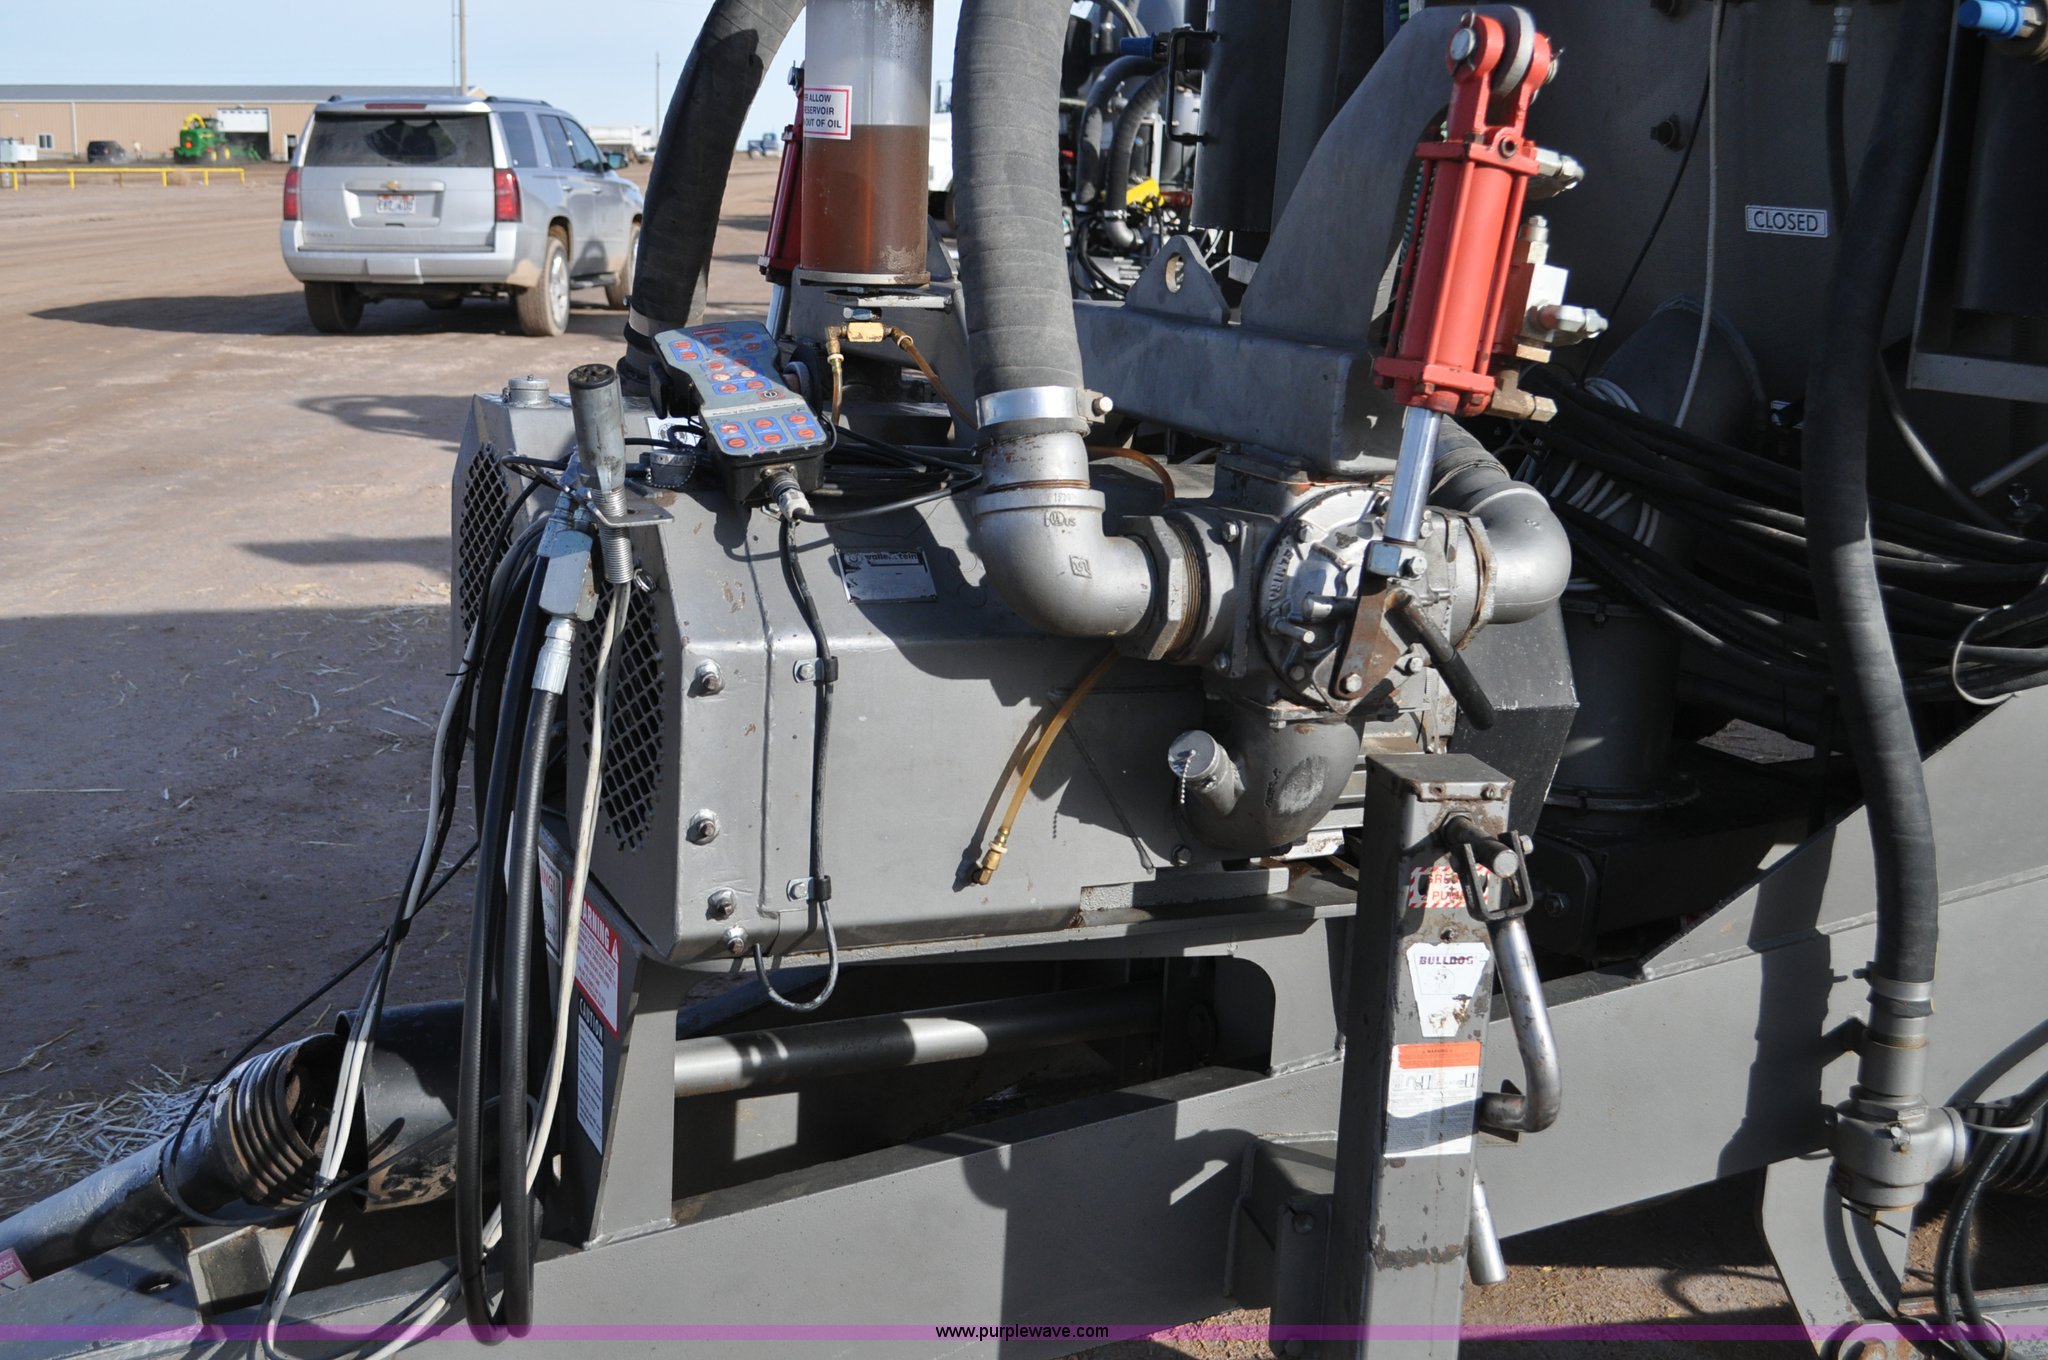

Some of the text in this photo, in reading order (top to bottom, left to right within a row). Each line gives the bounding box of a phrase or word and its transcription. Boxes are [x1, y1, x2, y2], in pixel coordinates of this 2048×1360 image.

[809, 94, 831, 103] ALLOW
[816, 118, 826, 128] OF
[827, 119, 842, 128] OIL
[1753, 210, 1818, 231] CLOSED
[582, 899, 610, 949] ARNING
[1419, 955, 1474, 965] BULLDOG
[579, 997, 603, 1043] CAUTION
